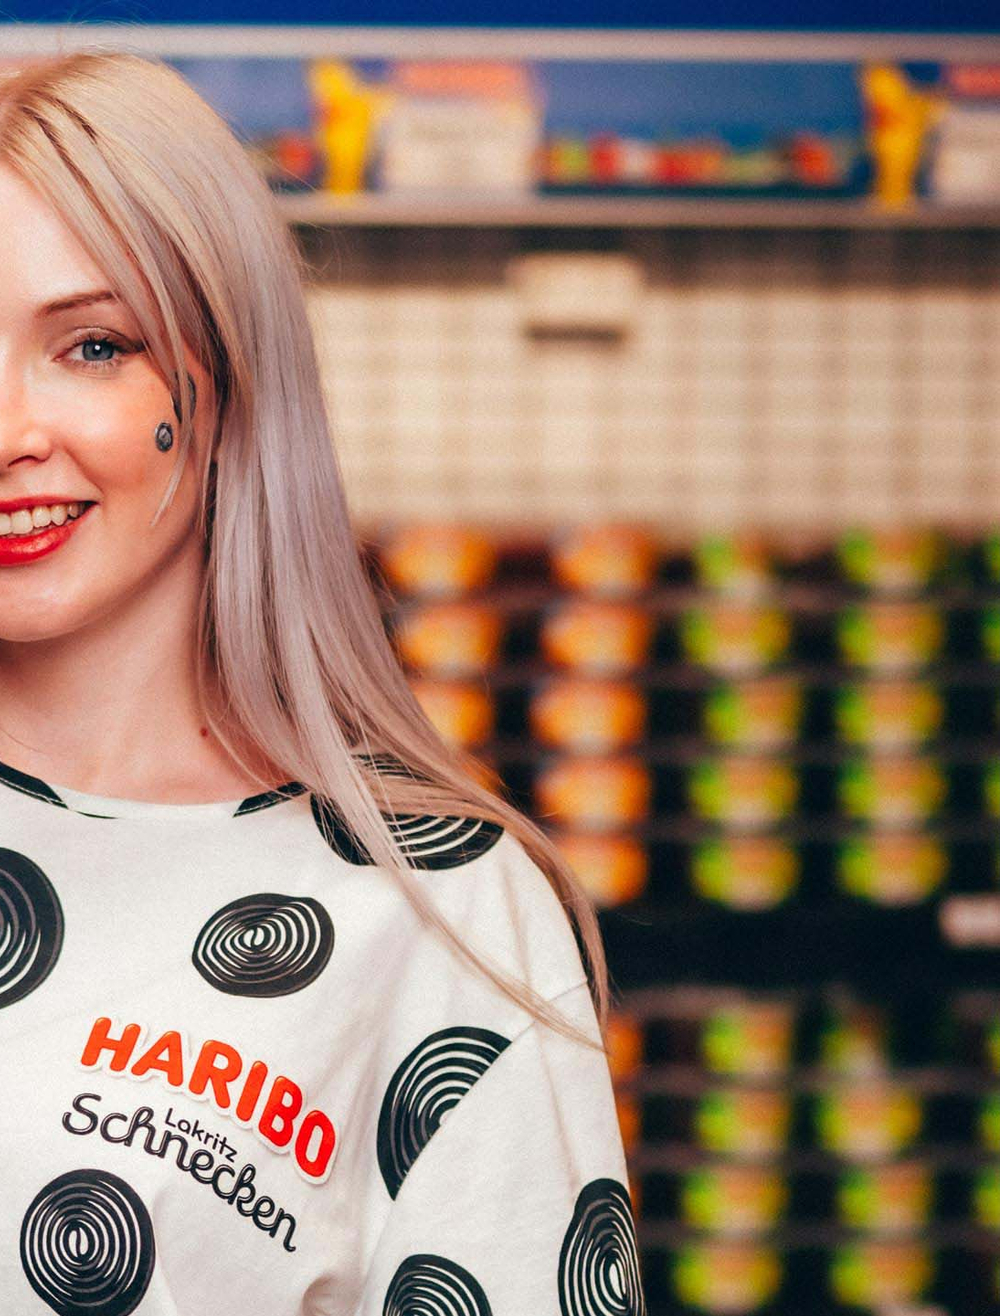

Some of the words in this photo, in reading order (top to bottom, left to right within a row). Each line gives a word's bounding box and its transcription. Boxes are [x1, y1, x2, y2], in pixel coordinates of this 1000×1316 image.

[61, 1091, 297, 1253] Schnecken
[80, 1016, 337, 1178] HARIBO
[164, 1107, 239, 1163] Lakritz
